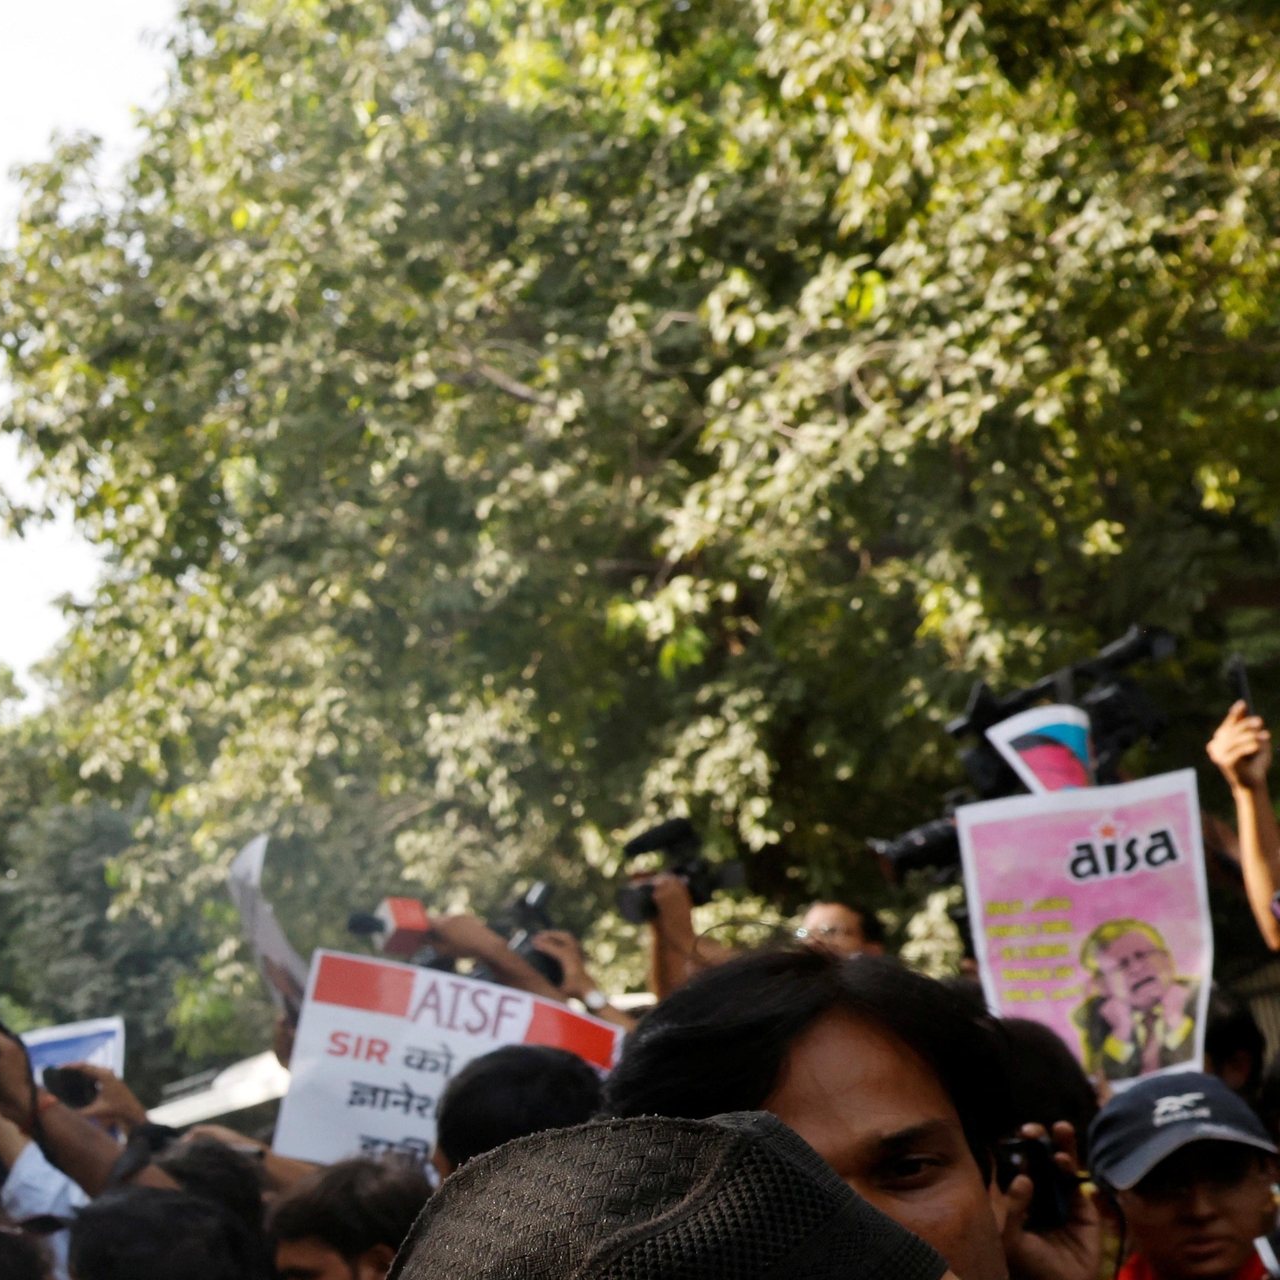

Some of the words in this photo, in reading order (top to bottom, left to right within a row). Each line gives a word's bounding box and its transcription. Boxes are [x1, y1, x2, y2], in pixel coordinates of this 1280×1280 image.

[1070, 824, 1178, 880] aisa
[409, 980, 526, 1039] AISF
[327, 1032, 390, 1065] SIR
[404, 1041, 454, 1078] को
